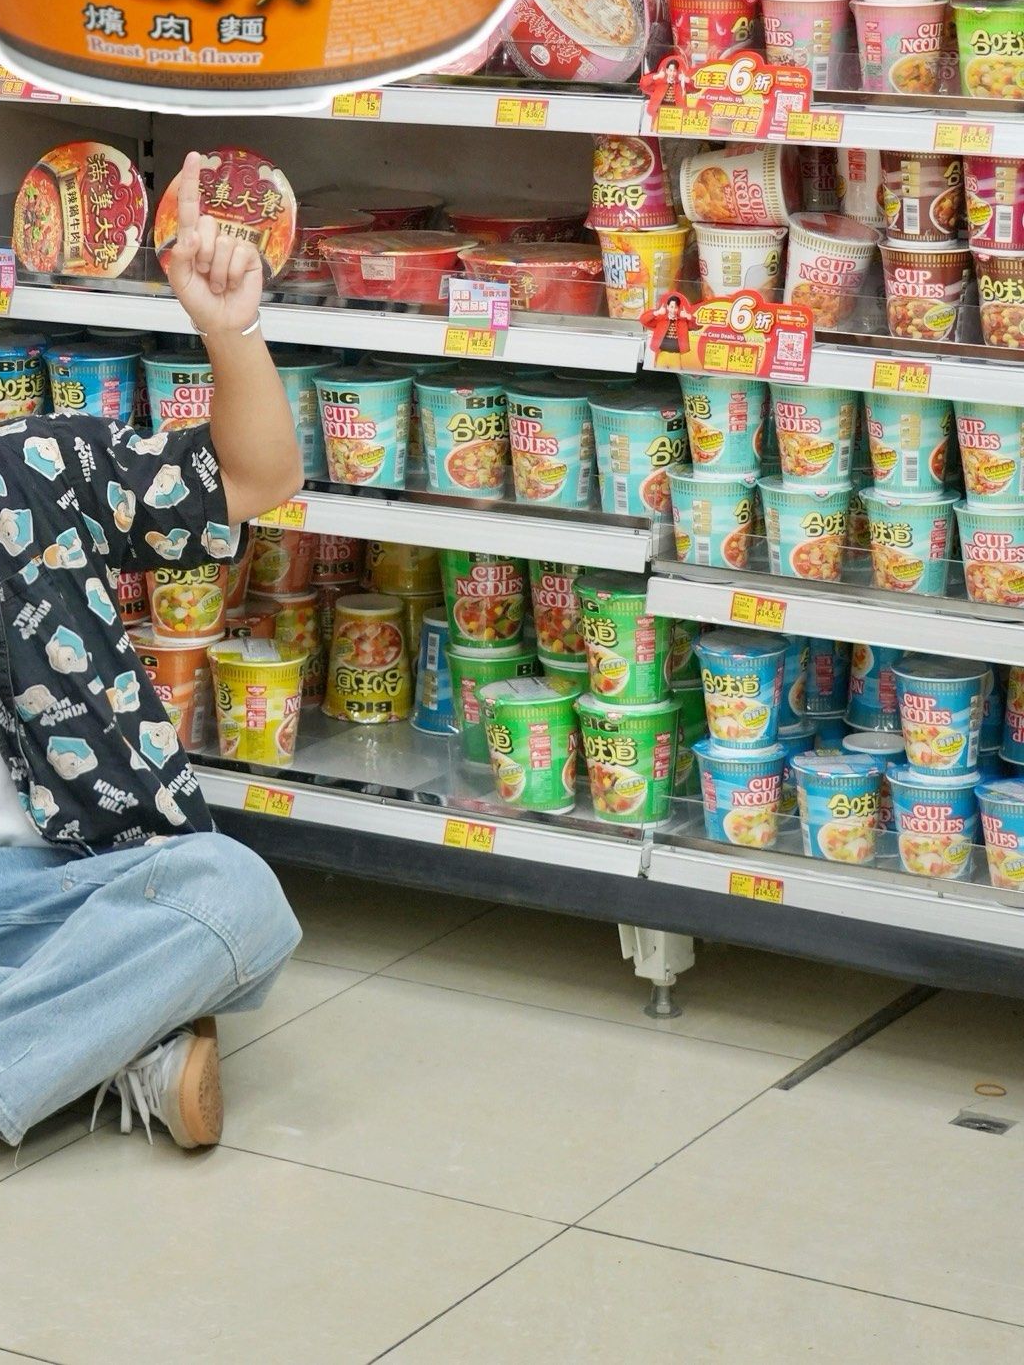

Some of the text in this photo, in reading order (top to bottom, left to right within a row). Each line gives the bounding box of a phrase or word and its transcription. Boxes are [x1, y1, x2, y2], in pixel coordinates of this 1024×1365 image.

[88, 37, 262, 66] Roast pork flavor
[694, 58, 774, 96] 低至6折
[746, 181, 764, 217] CUP
[815, 257, 855, 273] CUP
[799, 266, 865, 286] NOODLES
[895, 269, 932, 283] CUP
[695, 297, 773, 332] 低至6折
[172, 372, 213, 385] BIG
[321, 390, 360, 405] BIG
[465, 397, 507, 410] BIG
[324, 406, 359, 423] CUP
[777, 403, 806, 417] CUP
[973, 532, 1013, 547] CUP
[964, 545, 1024, 562] NOODLES
[471, 565, 515, 580] CUP
[455, 578, 524, 594] NOODLES
[756, 608, 783, 620] $14.5/2
[702, 669, 760, 698] 合味道
[903, 694, 936, 710] CUP
[913, 806, 953, 820] CUP
[902, 817, 965, 834] NOODLES
[755, 888, 781, 900] $14.5/2
